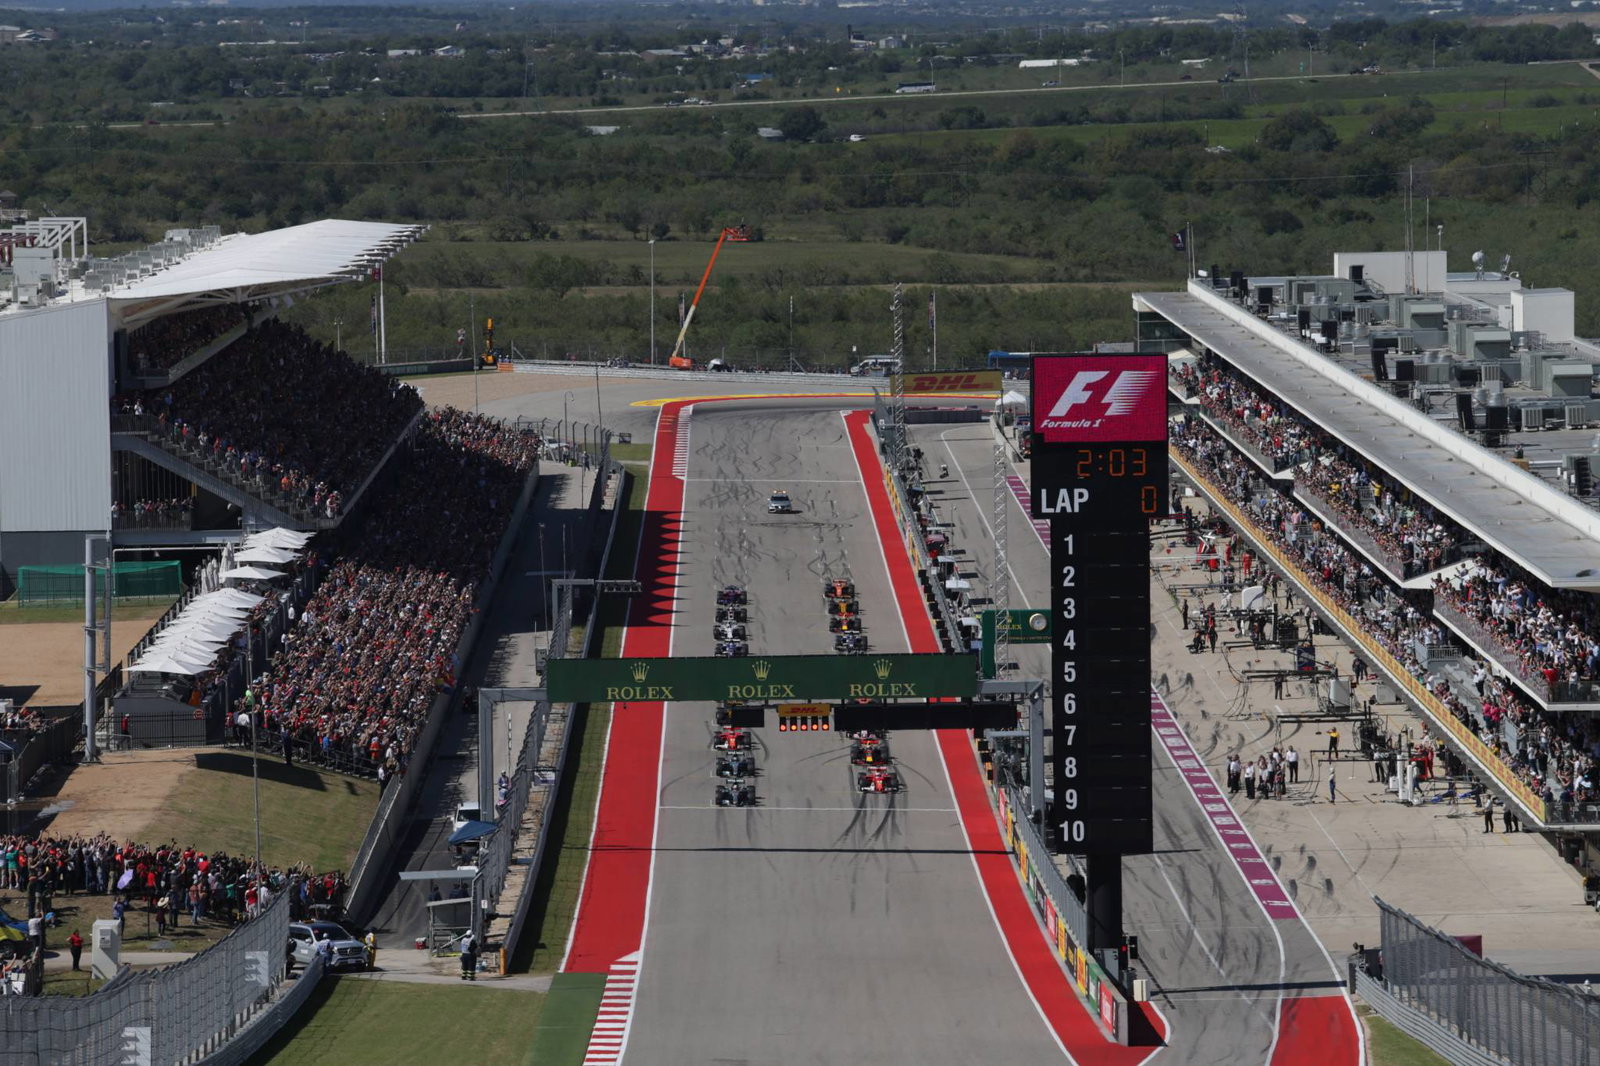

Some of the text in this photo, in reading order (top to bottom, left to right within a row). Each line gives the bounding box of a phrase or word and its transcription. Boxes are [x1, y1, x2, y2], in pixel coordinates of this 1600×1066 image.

[912, 374, 981, 391] DHL
[1048, 371, 1159, 416] F1
[1041, 419, 1101, 428] Formula 1
[1077, 449, 1146, 477] 2:03
[1041, 486, 1157, 513] LAP 0
[1064, 534, 1073, 555] 1
[1063, 566, 1075, 587] 2
[1063, 598, 1076, 619] 3
[1063, 630, 1076, 650] 4
[1064, 662, 1076, 683] 5
[606, 686, 674, 701] ROLEX
[728, 684, 795, 699] ROLEX
[849, 683, 917, 698] ROLEX
[1064, 694, 1076, 714] 6
[1064, 725, 1077, 746] 7
[1065, 757, 1077, 778] 8
[1065, 789, 1077, 810] 9
[1059, 820, 1085, 842] 10
